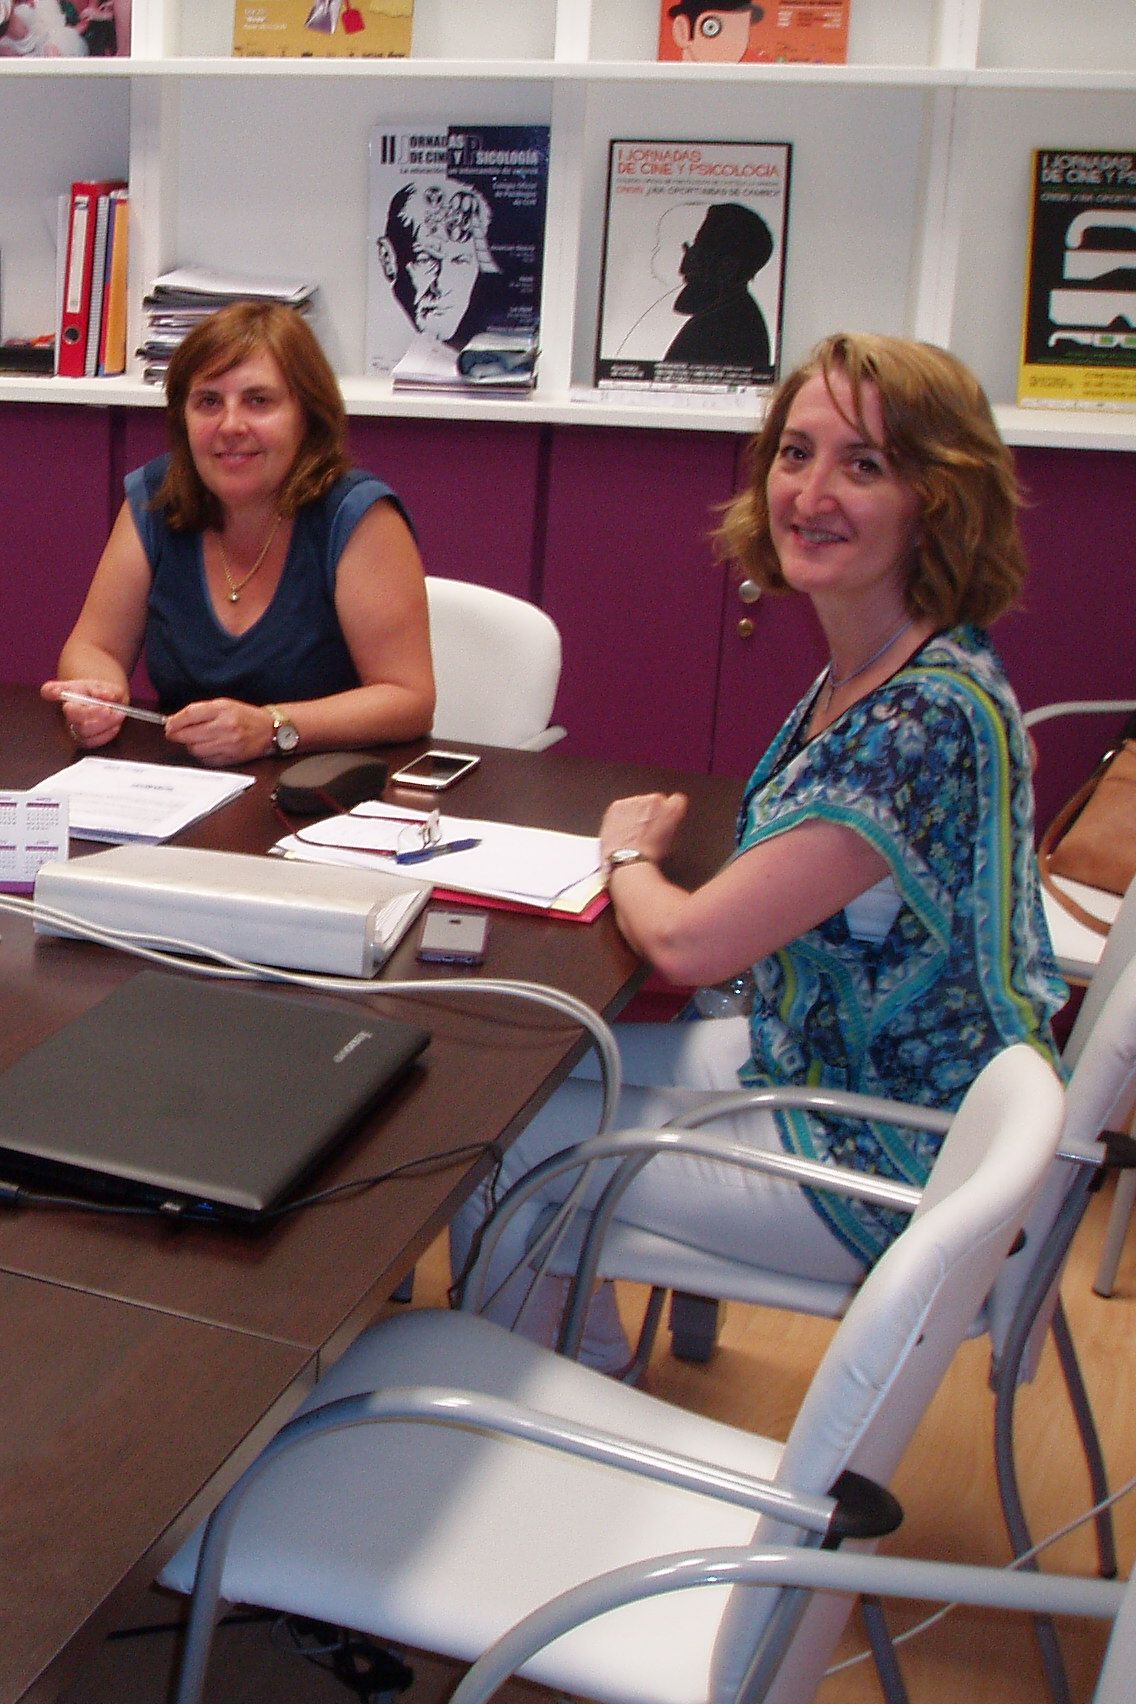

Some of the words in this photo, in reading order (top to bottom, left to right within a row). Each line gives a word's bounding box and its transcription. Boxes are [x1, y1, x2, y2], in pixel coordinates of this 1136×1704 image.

[627, 149, 702, 162] JORNADAS
[618, 162, 636, 175] DE
[641, 162, 672, 175] CINE
[677, 163, 686, 175] Y
